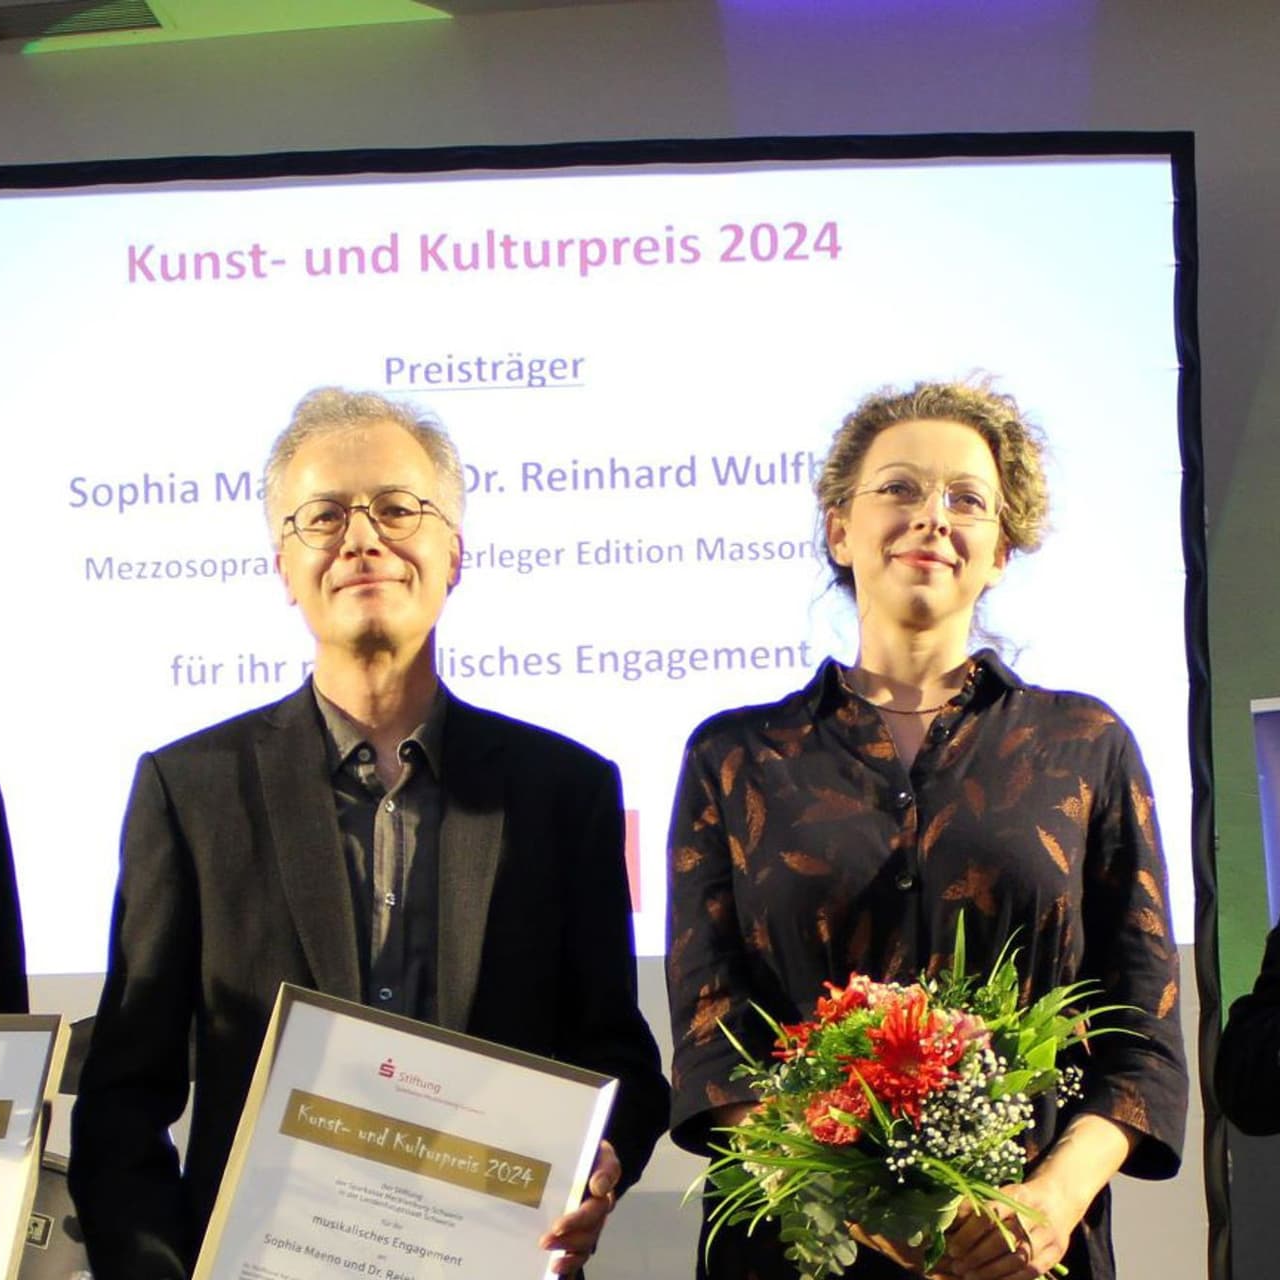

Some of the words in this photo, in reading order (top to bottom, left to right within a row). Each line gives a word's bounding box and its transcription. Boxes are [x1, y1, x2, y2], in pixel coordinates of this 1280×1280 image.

[128, 243, 286, 283] Kunst-
[305, 233, 399, 276] und
[419, 225, 701, 277] Kulturpreis
[719, 221, 843, 263] 2024
[384, 353, 586, 388] Preisträger
[69, 472, 200, 513] Sophia
[521, 455, 697, 492] Reinhard
[84, 556, 277, 582] Mezzosopra
[460, 544, 565, 573] erleger
[576, 539, 684, 566] Edition
[696, 537, 816, 561] Masson
[171, 654, 224, 686] für
[238, 654, 286, 684] ihr
[437, 645, 562, 677] lisches
[576, 640, 811, 680] Engagement
[398, 1071, 442, 1094] Stiftung
[298, 1104, 351, 1133] Kunst-
[358, 1127, 389, 1146] und
[394, 1131, 480, 1174] Kulturpreis
[484, 1159, 534, 1188] 2024
[263, 1233, 302, 1254] Sophia
[343, 1258, 367, 1273] und
[367, 1264, 383, 1278] Dr.
[312, 1214, 390, 1246] musikalisches
[391, 1237, 463, 1267] Engagement
